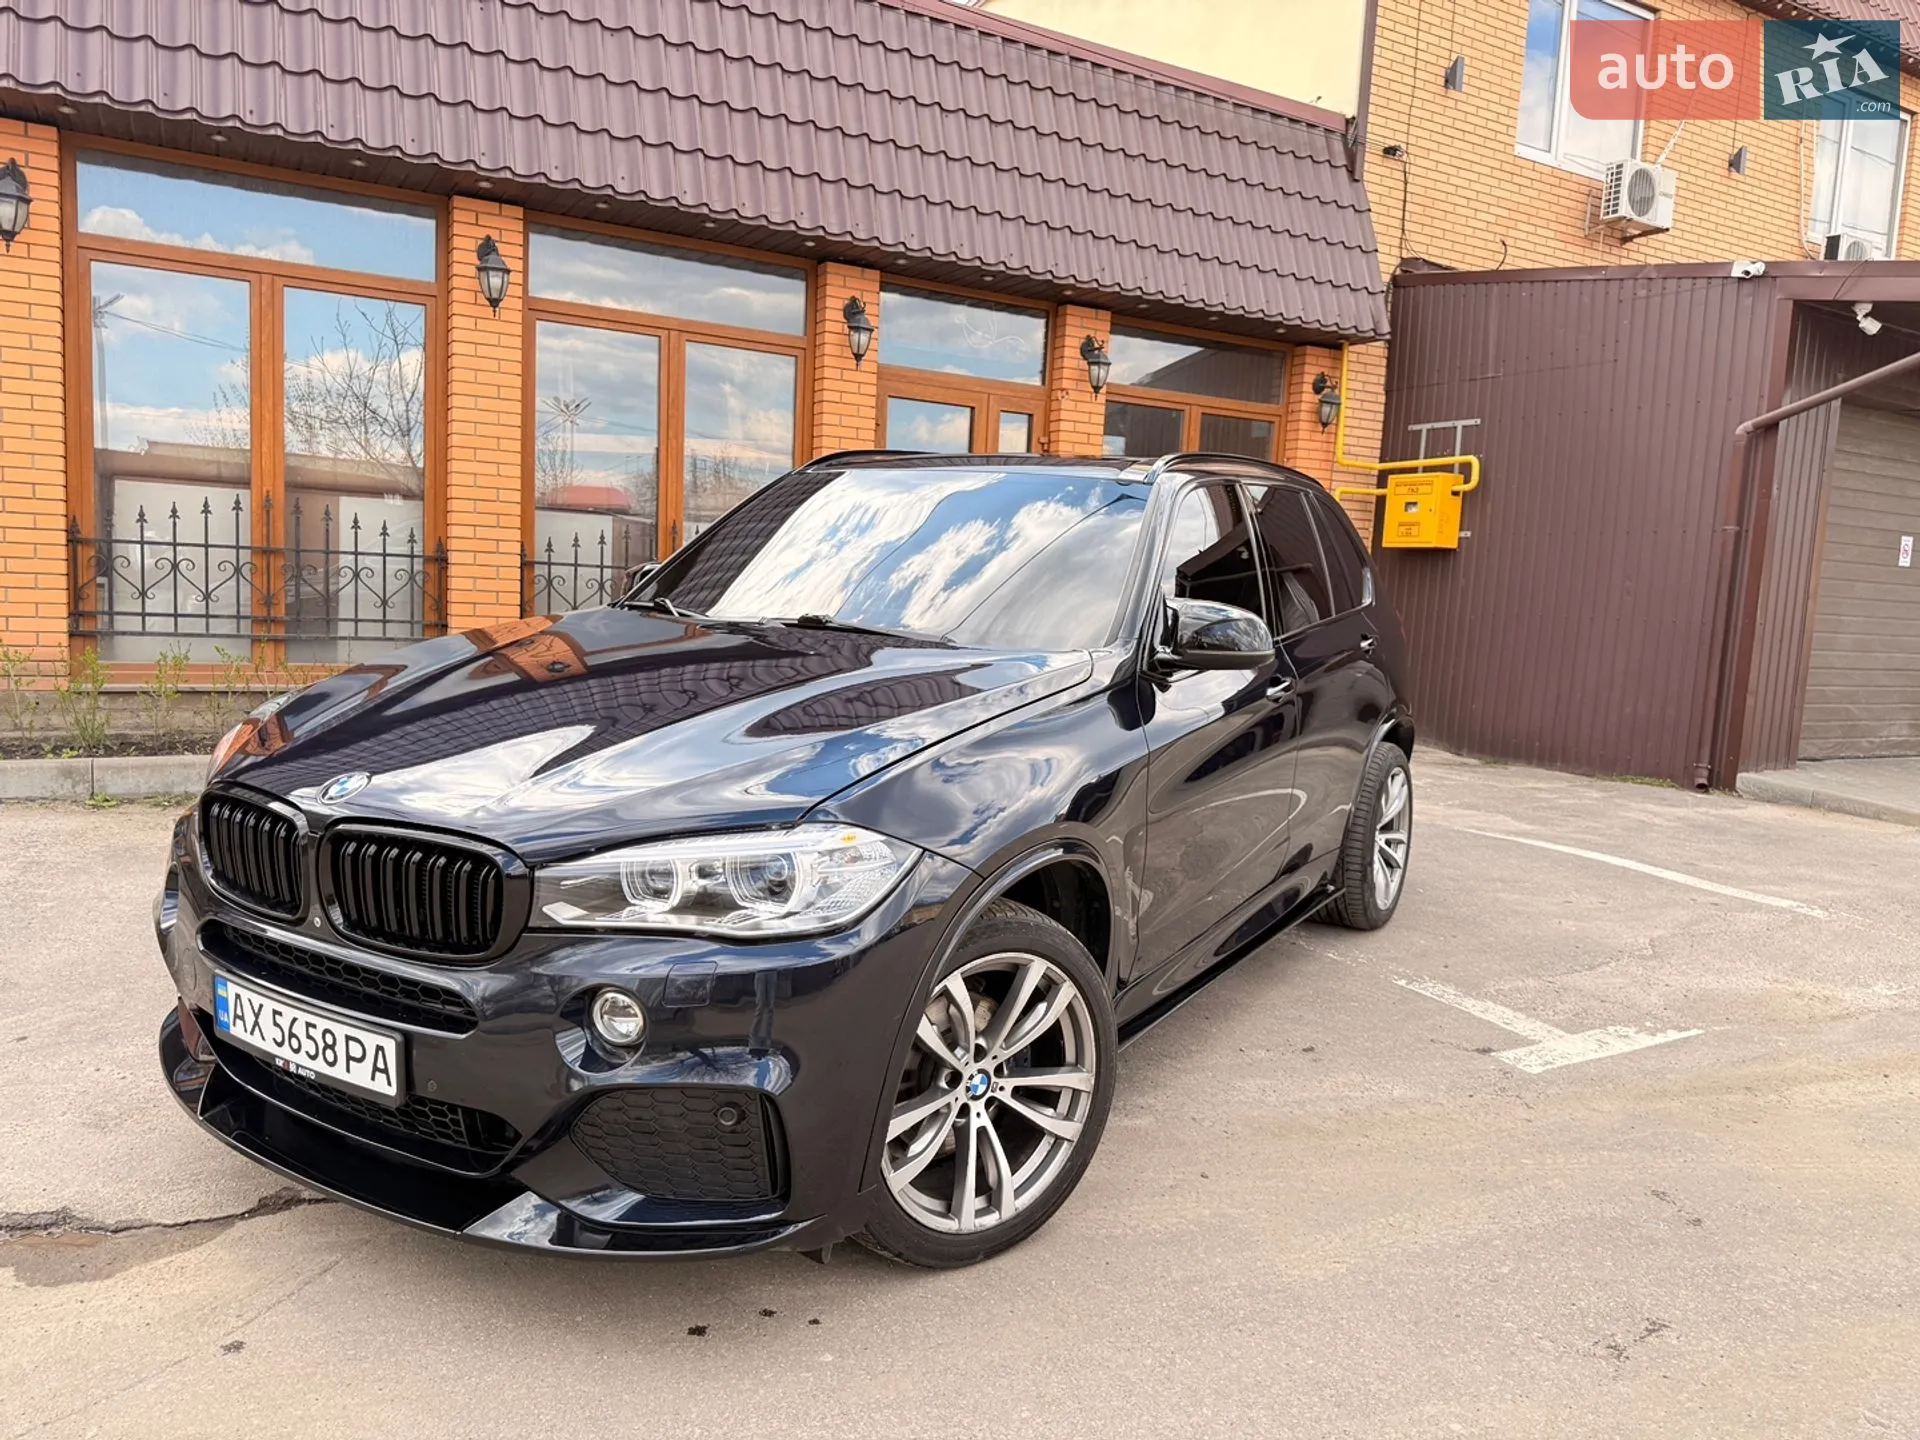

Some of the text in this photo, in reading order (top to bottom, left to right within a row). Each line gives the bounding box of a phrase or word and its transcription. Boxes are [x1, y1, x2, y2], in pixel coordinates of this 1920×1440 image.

[219, 1010, 229, 1022] UA
[232, 992, 392, 1088] AX 5658 PA
